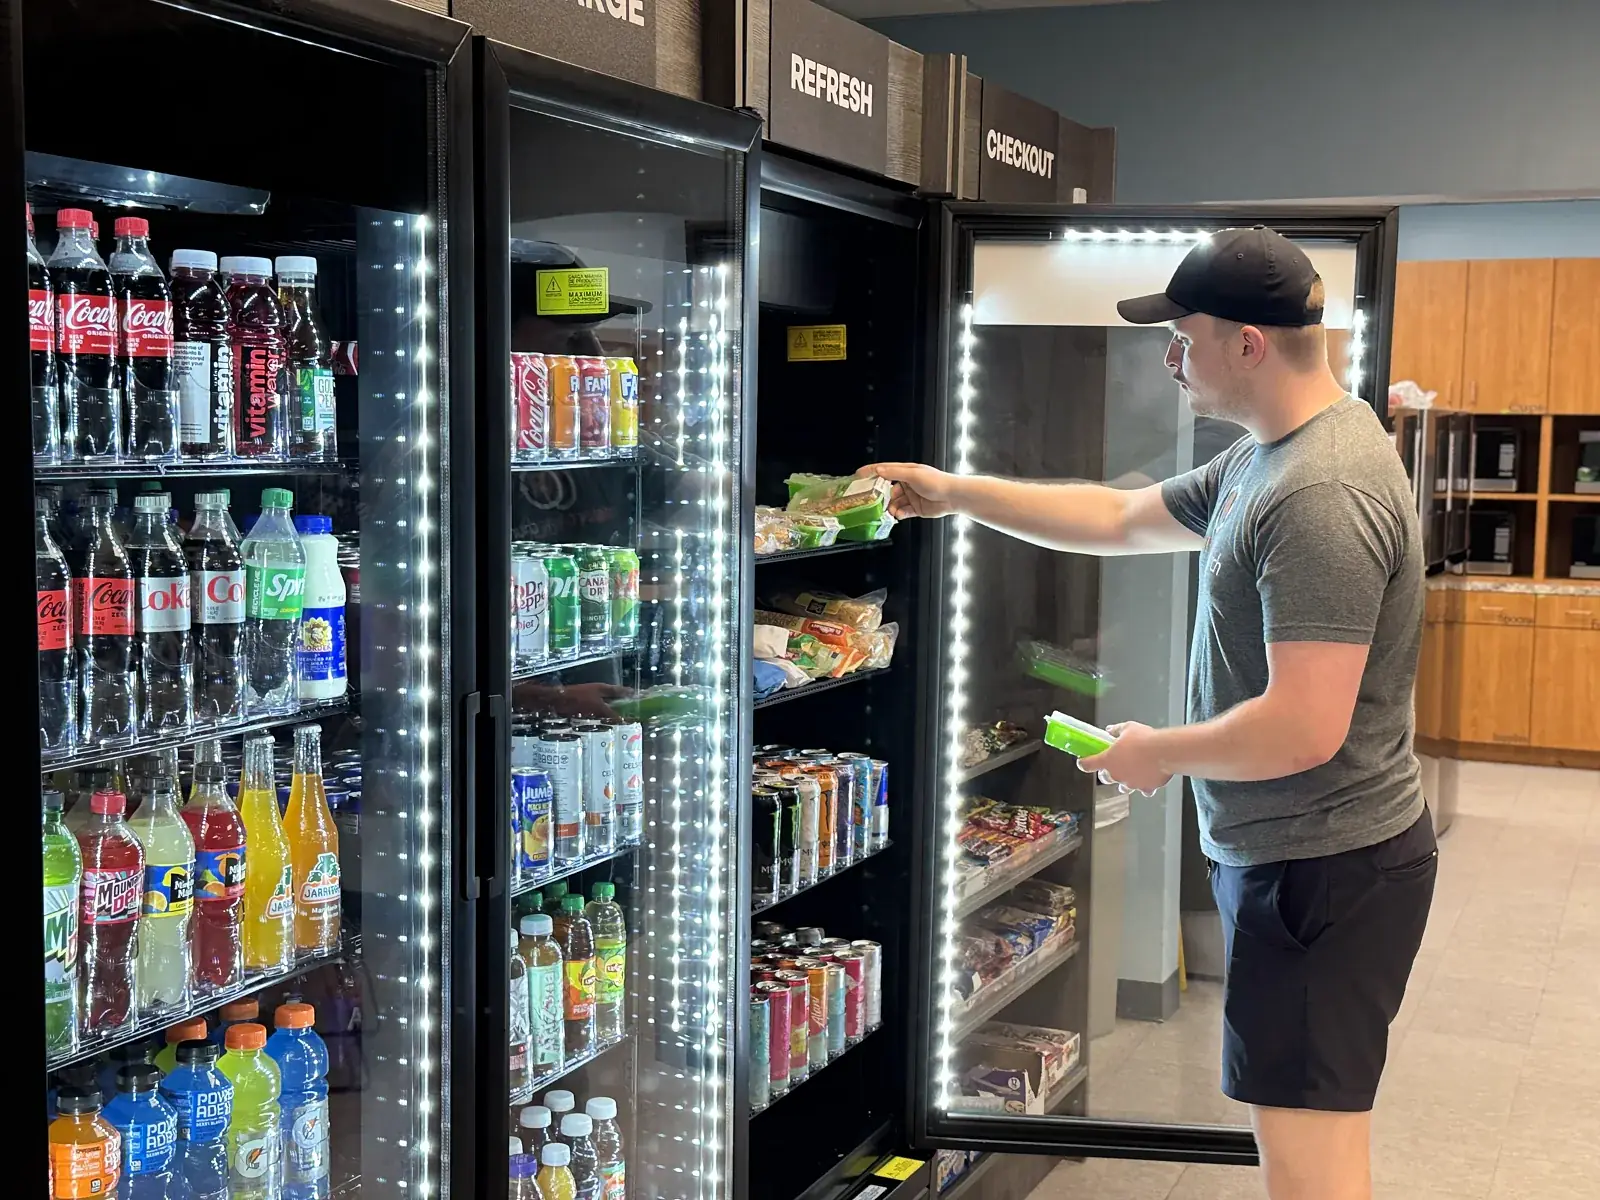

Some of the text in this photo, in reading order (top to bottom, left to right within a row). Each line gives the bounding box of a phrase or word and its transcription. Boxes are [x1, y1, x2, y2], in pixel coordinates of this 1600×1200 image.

[791, 52, 873, 118] REFRESH
[986, 129, 1055, 179] CHECKOUT
[214, 344, 229, 439] vitamin
[245, 349, 266, 438] vitamin
[251, 582, 261, 616] RECYCLE
